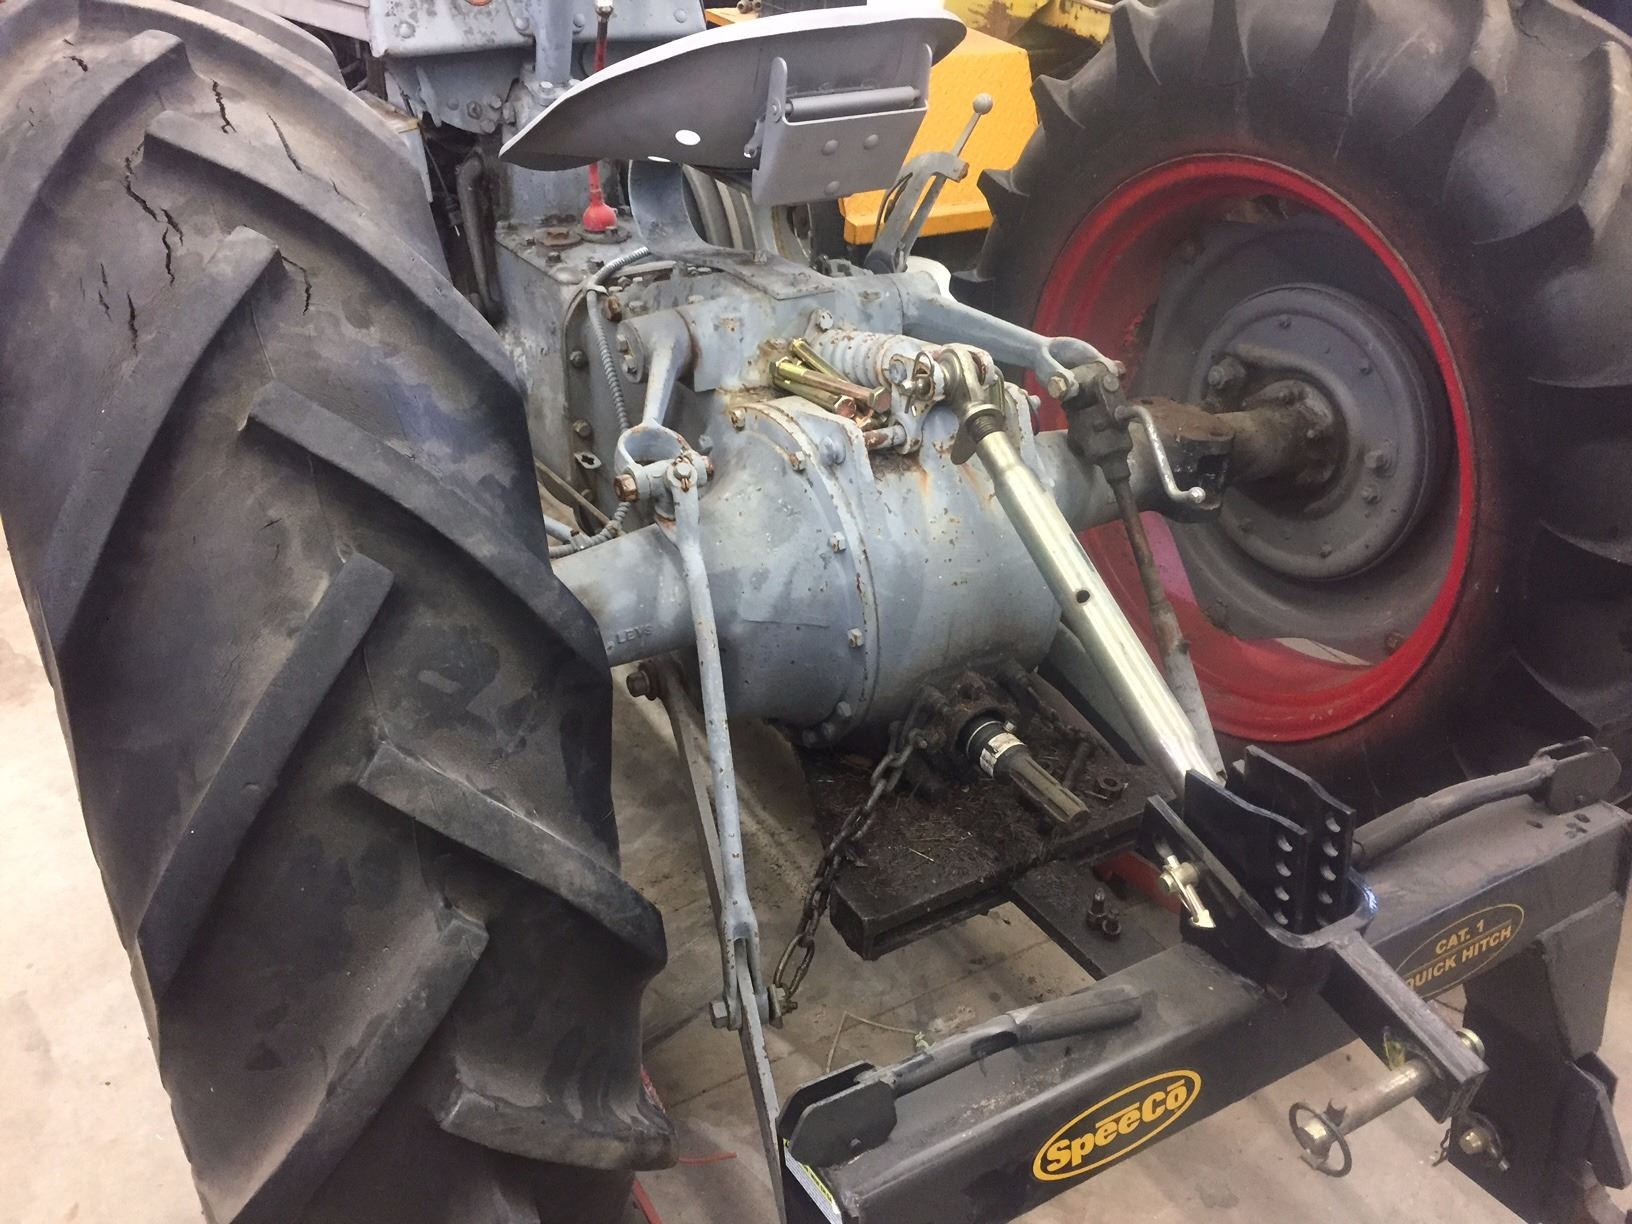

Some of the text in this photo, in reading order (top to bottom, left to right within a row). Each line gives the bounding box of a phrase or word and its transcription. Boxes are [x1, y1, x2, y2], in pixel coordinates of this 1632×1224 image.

[1435, 919, 1485, 954] CAT. 1
[1461, 925, 1513, 963] HITCH
